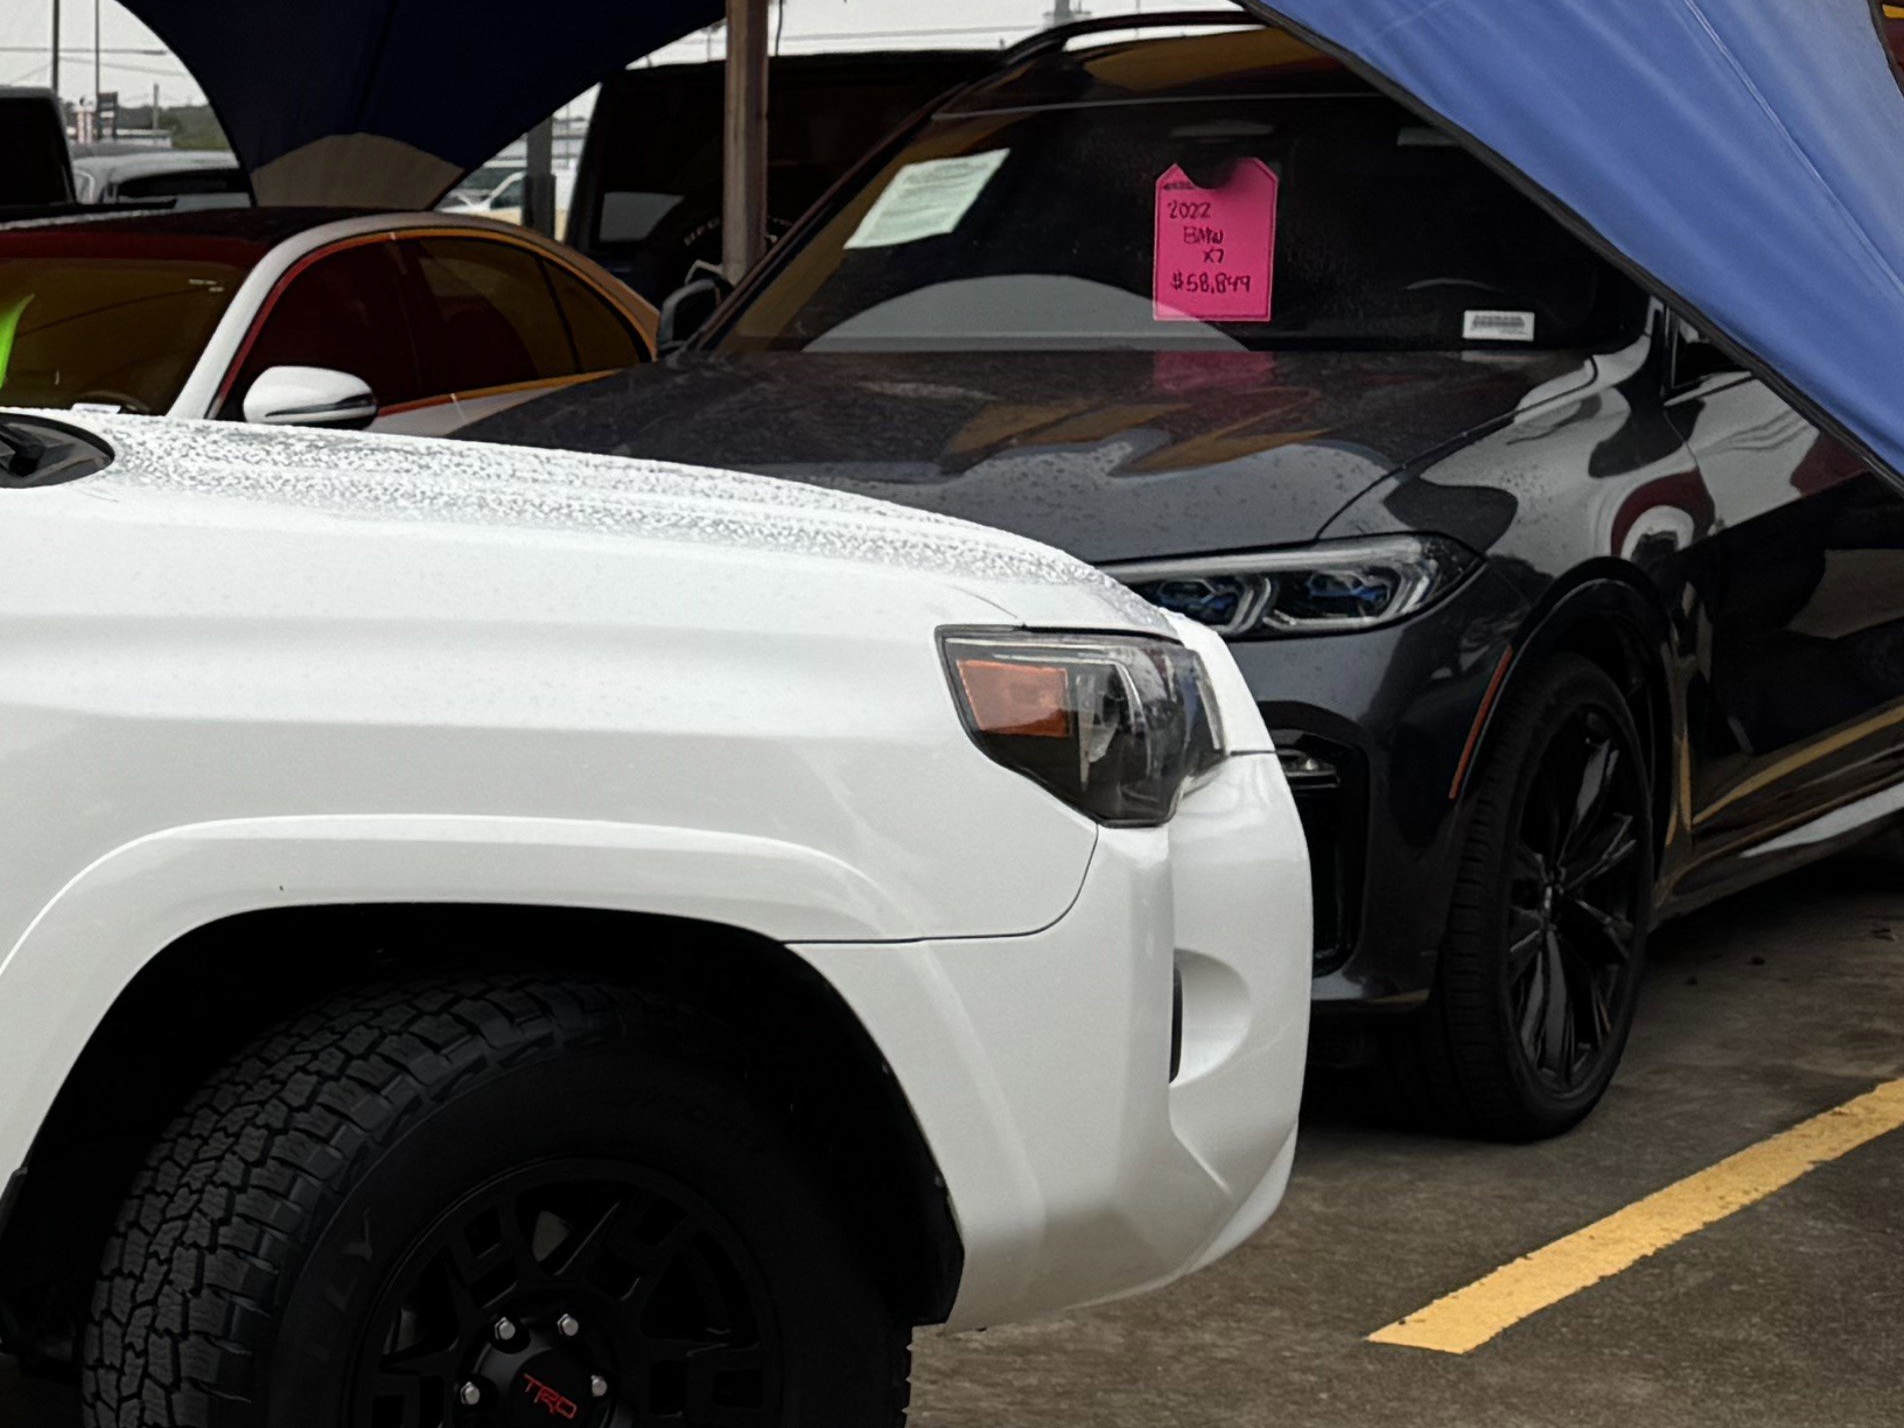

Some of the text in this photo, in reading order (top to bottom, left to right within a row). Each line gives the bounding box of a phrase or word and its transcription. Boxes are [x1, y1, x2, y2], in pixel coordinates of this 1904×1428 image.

[1167, 200, 1211, 220] 2022
[1183, 225, 1224, 245] BMW
[522, 1372, 579, 1421] TRD
